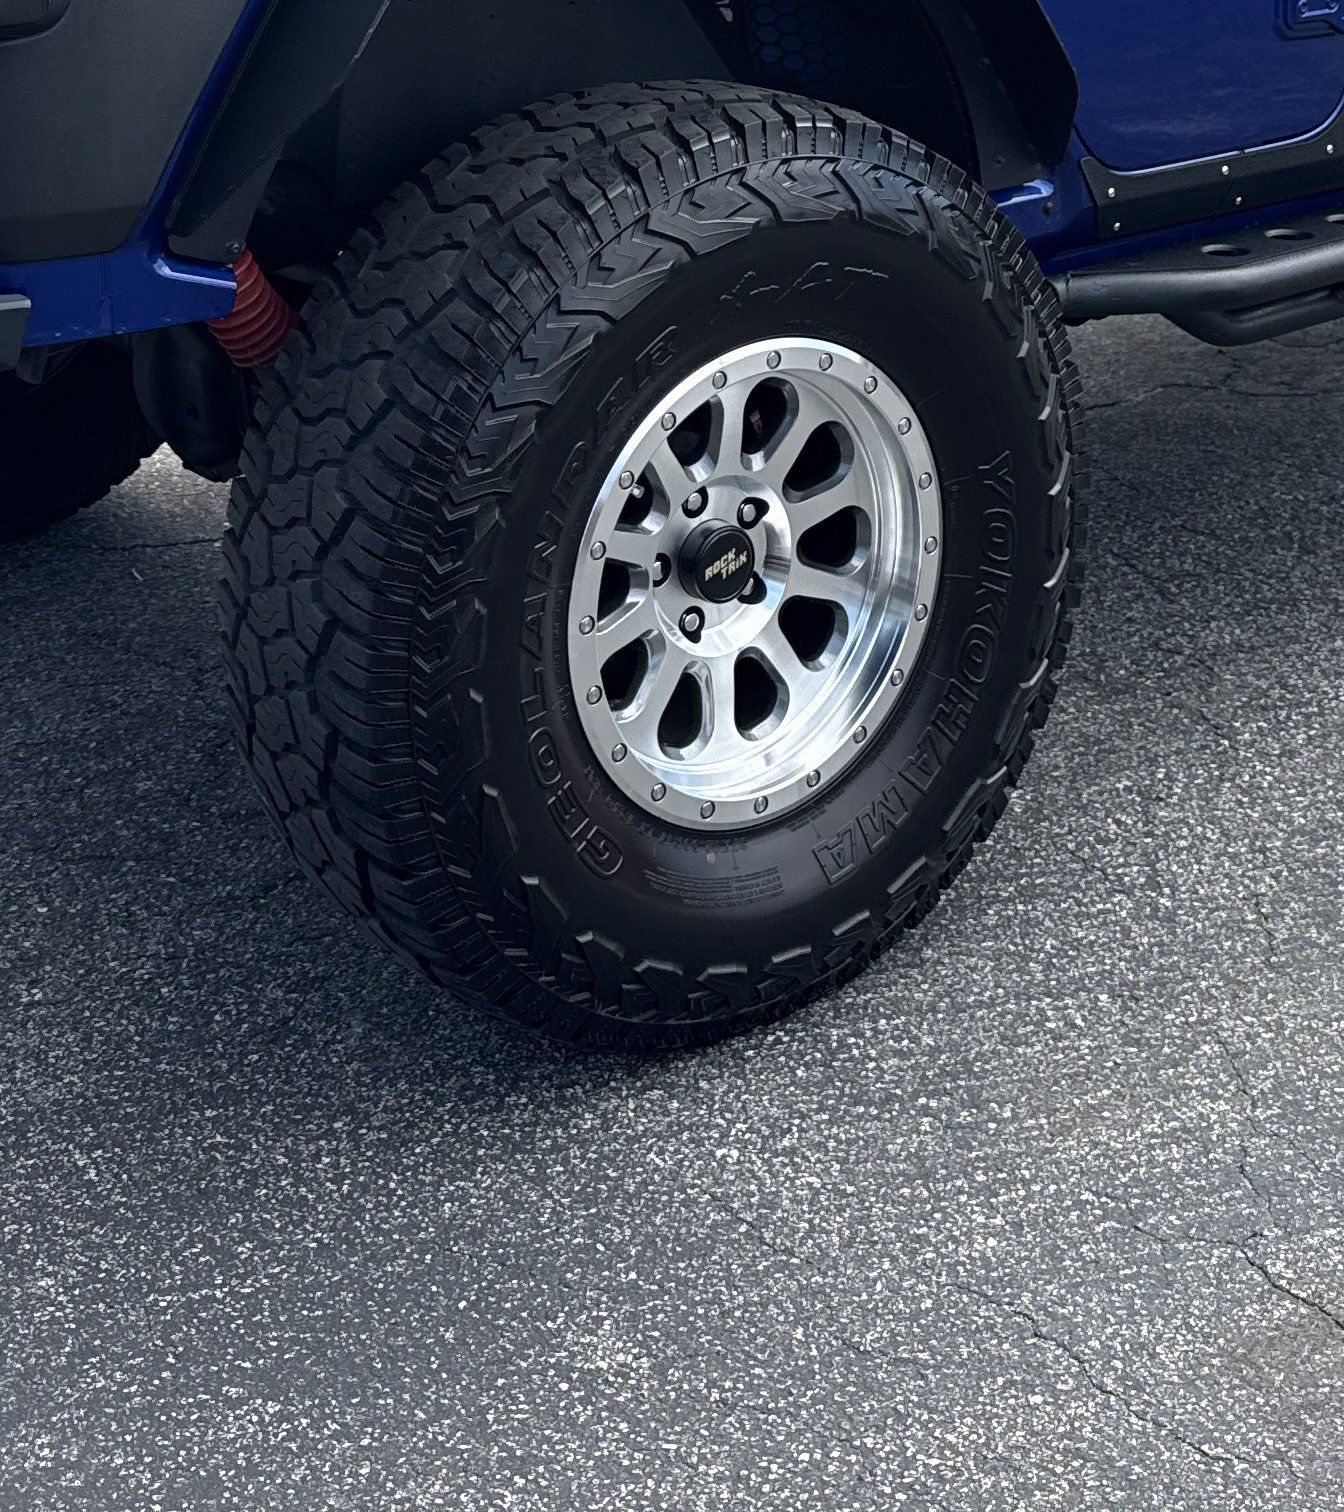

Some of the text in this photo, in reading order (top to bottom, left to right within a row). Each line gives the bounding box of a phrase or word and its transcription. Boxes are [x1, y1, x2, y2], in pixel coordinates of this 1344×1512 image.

[518, 324, 679, 878] GEOLANDAR
[704, 547, 736, 582] ROCK
[811, 449, 1018, 885] YOKOHAMA
